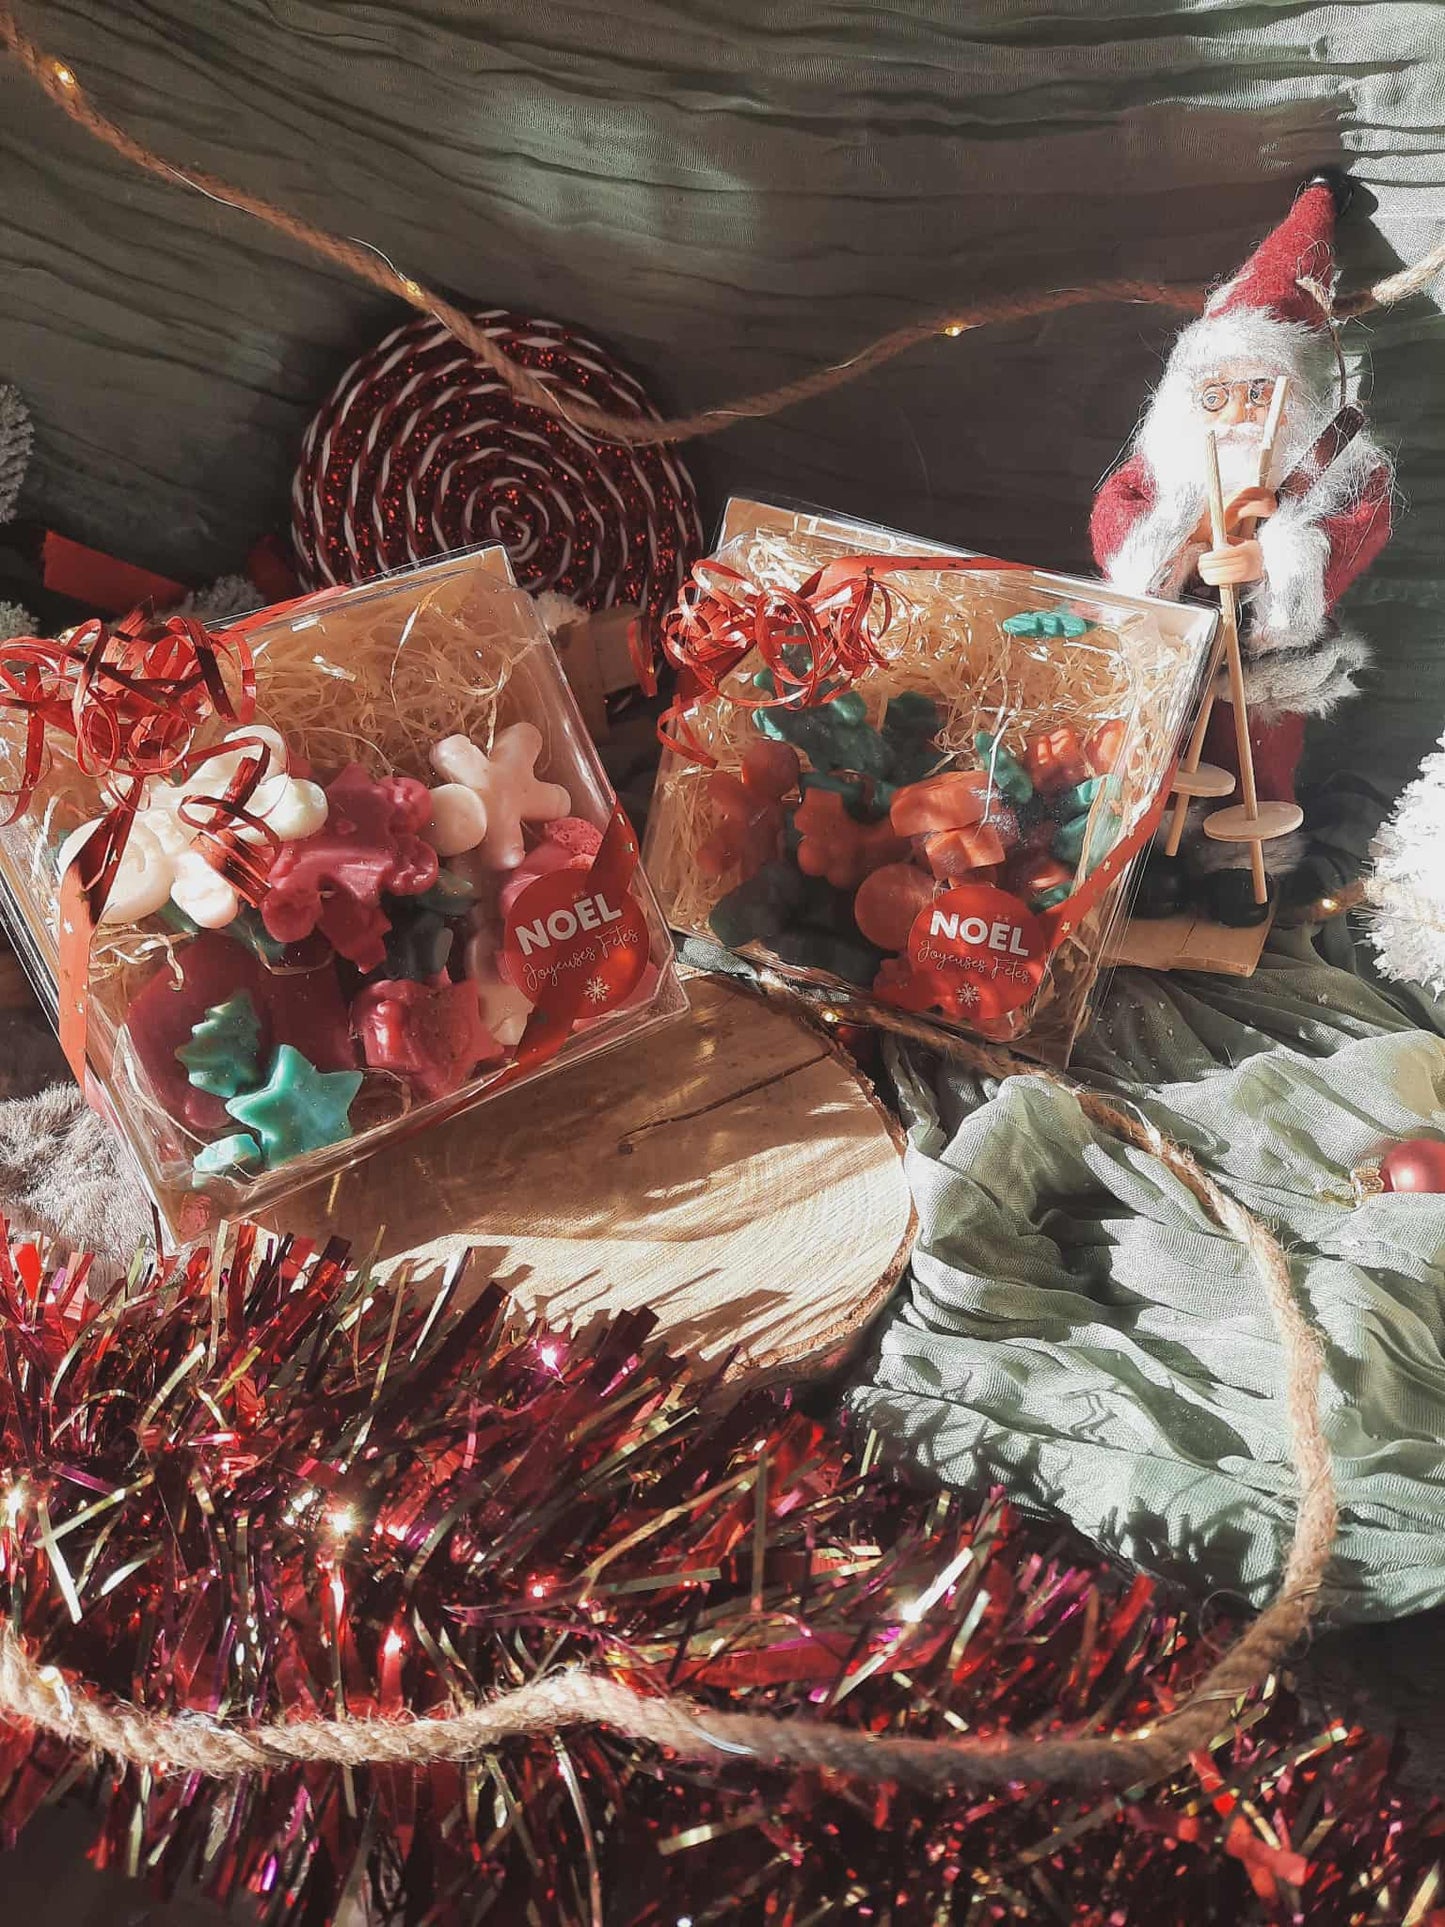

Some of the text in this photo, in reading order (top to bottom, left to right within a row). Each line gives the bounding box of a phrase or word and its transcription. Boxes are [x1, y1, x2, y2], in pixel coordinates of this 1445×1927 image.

[514, 890, 622, 956] NOËL
[930, 910, 1029, 957] NOËL
[522, 946, 596, 991] Joyeuses
[918, 940, 987, 970] Joyeuses
